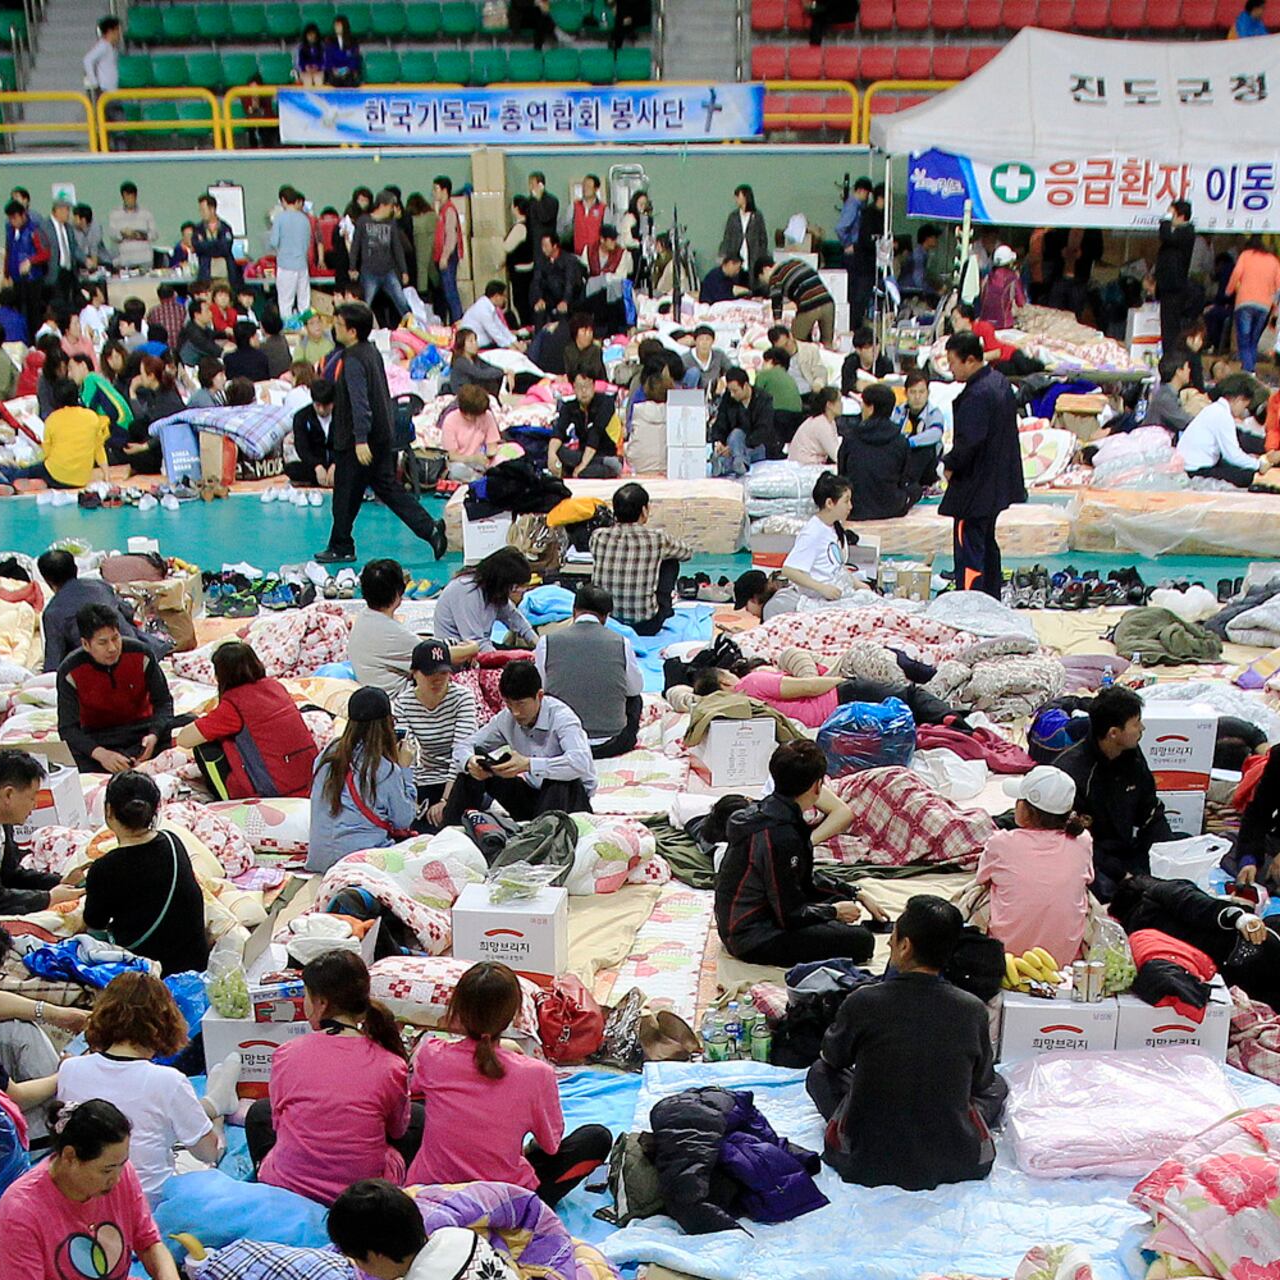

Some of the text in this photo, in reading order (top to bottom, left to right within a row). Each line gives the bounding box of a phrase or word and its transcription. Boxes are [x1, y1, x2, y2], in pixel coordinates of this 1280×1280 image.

[1069, 71, 1268, 107] 진도군청
[364, 97, 686, 133] 한국기독교 총연합회 봉사단
[1044, 157, 1191, 208] 응급환자
[479, 941, 530, 953] 희망브리지
[1031, 1038, 1088, 1050] 희망브리지
